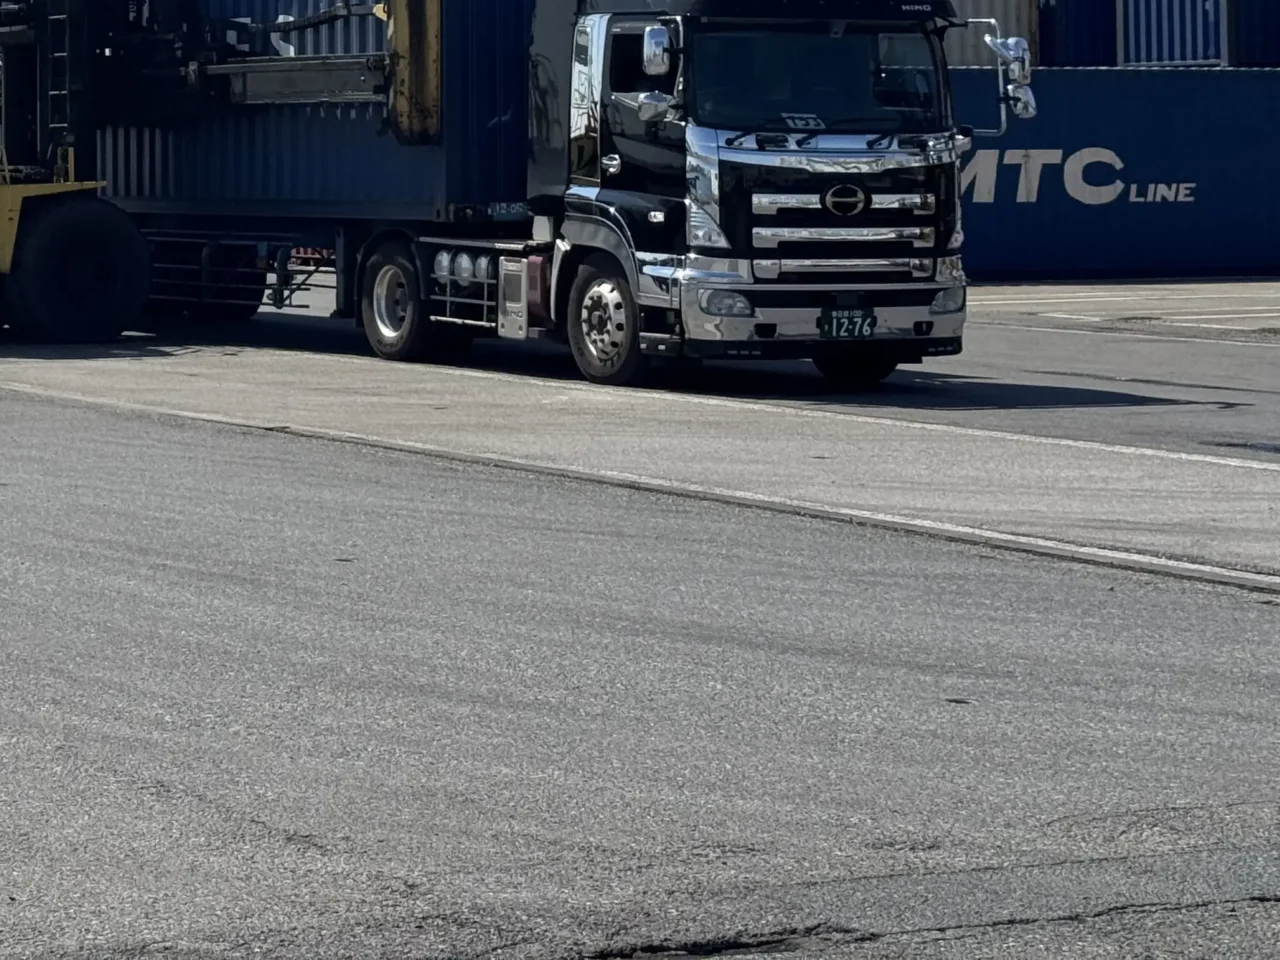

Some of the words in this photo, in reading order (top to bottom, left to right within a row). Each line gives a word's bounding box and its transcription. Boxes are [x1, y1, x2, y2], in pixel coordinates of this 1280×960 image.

[901, 4, 932, 12] HINO
[1129, 183, 1198, 203] LINE
[832, 318, 872, 337] 12-76
